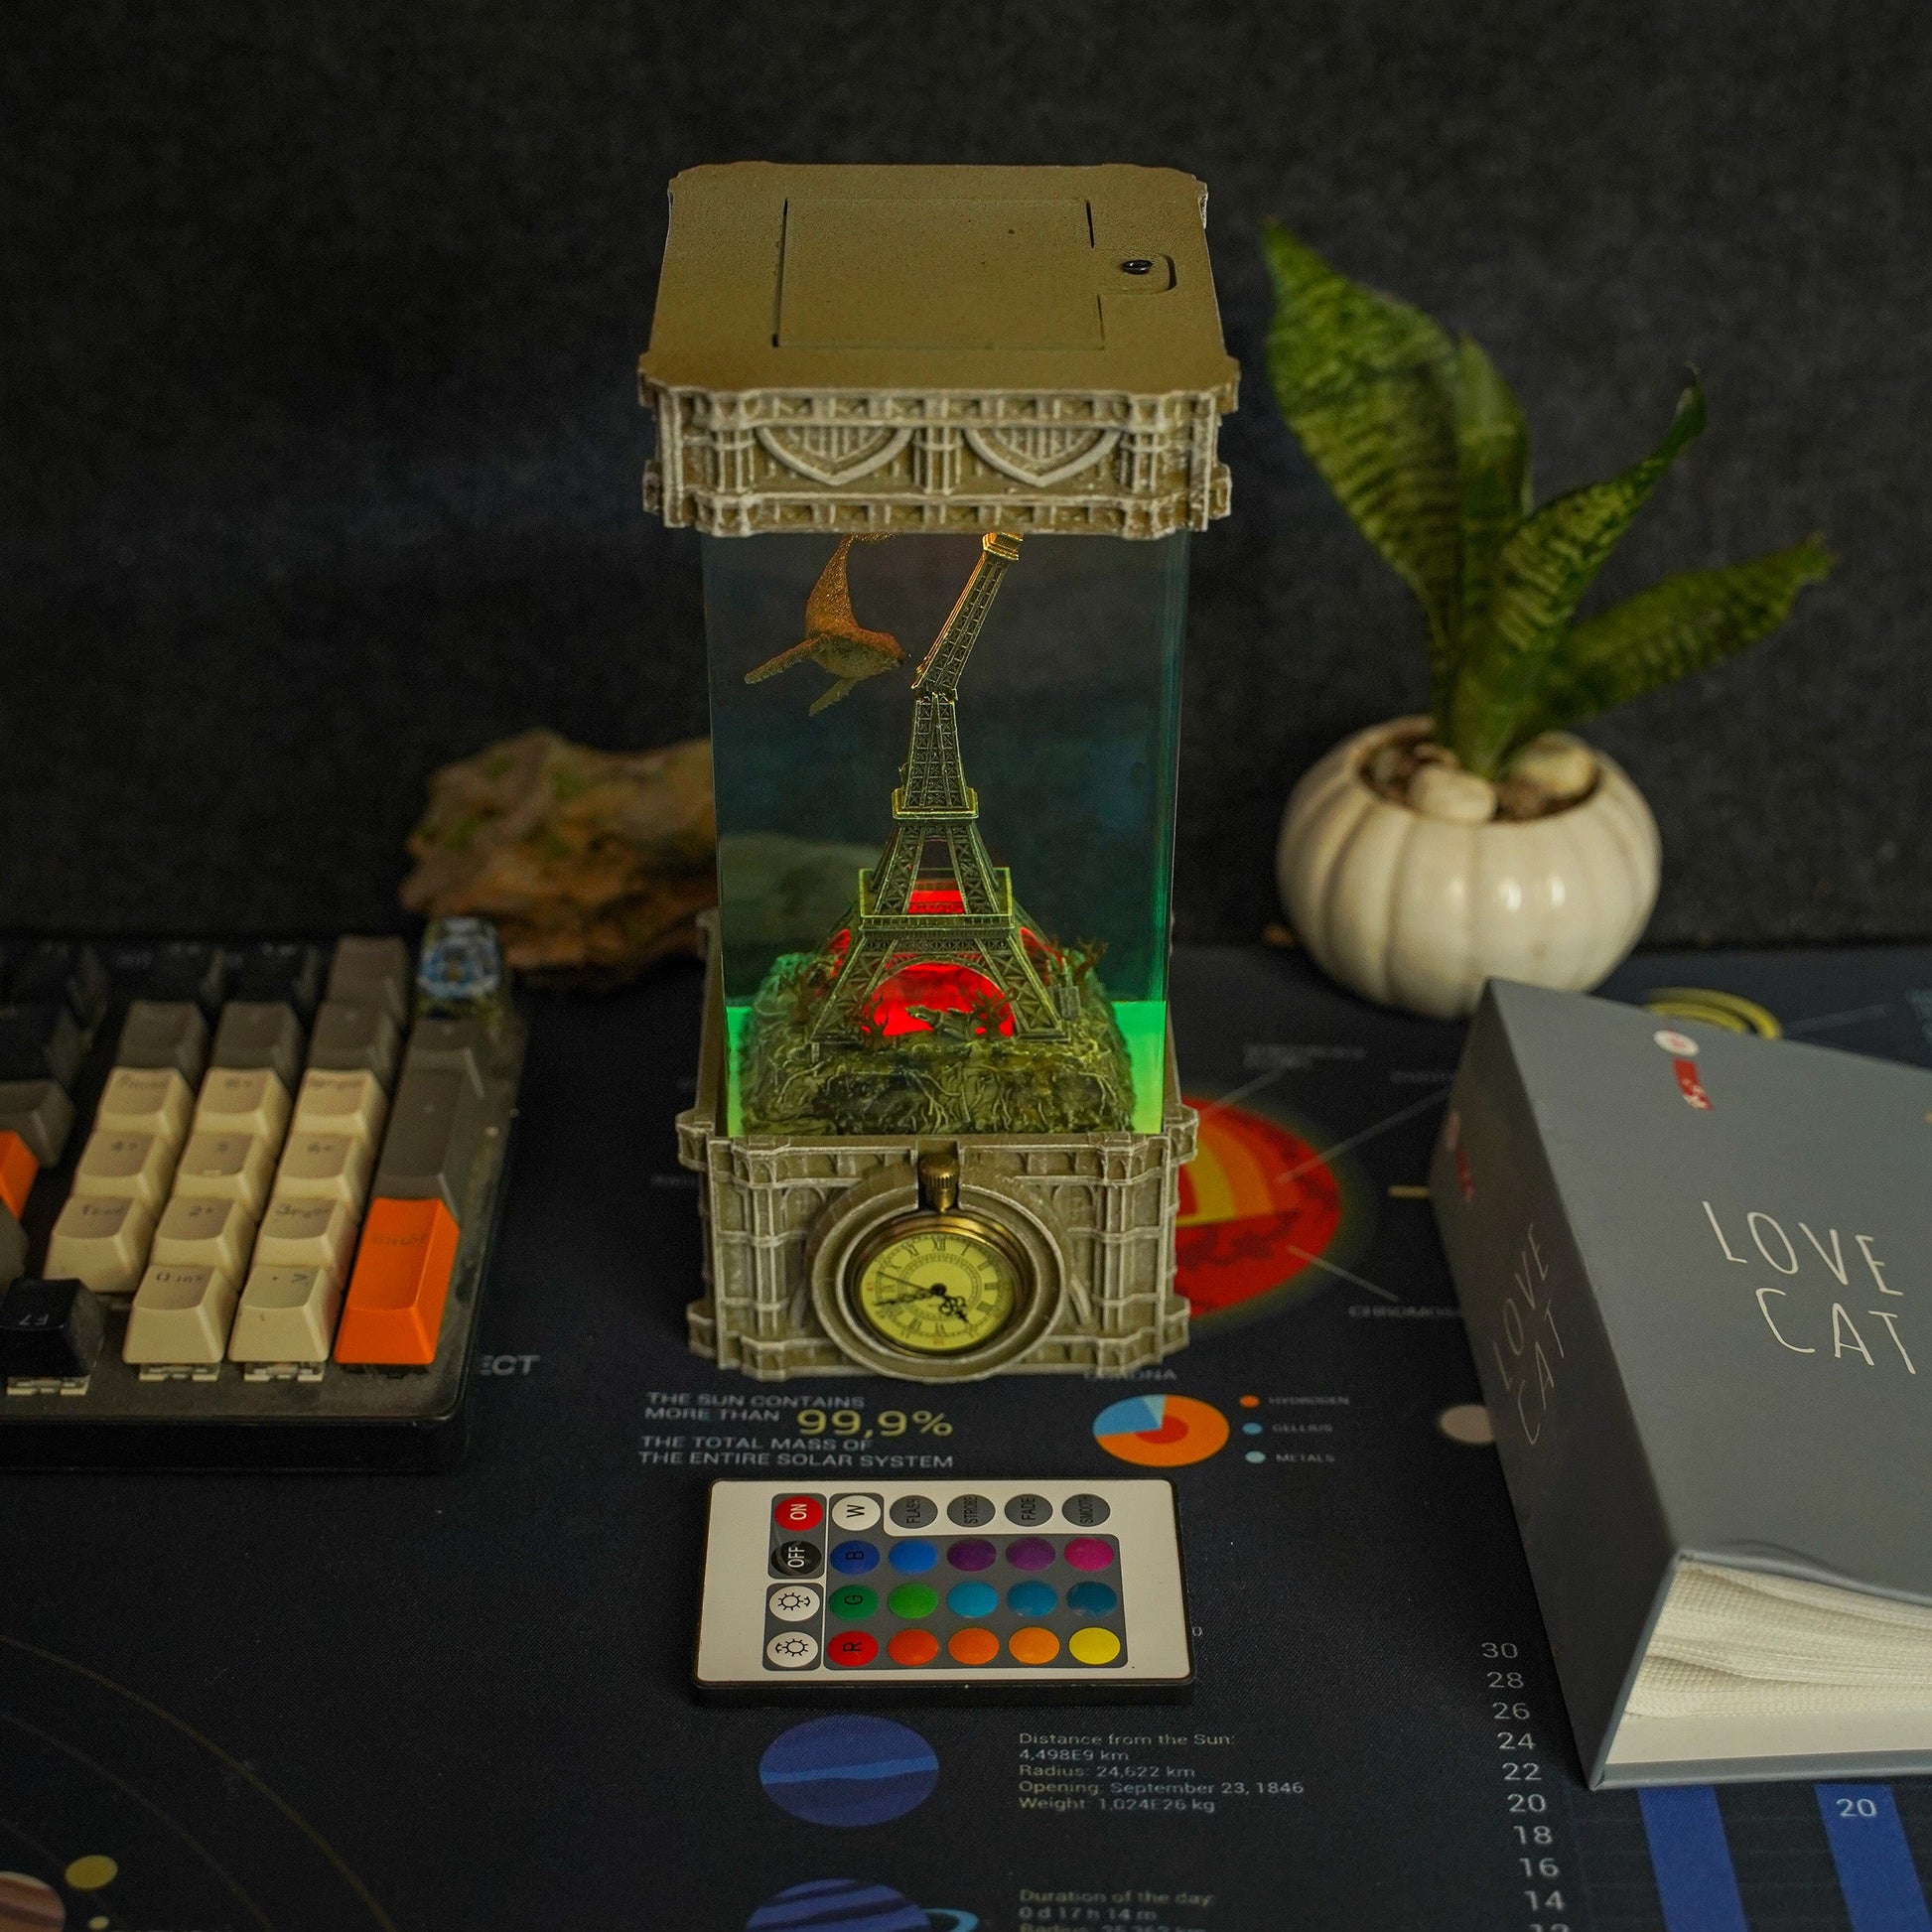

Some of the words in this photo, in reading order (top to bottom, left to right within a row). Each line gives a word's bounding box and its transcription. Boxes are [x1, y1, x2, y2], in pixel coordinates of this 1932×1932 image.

[1702, 1200, 1904, 1297] LOVE
[1492, 1222, 1549, 1391] LOVE
[1755, 1288, 1916, 1375] CAT
[1516, 1299, 1565, 1446] CAT
[646, 1392, 691, 1406] THE
[697, 1393, 745, 1408] SUN
[750, 1395, 865, 1409] CONTAINS
[645, 1407, 712, 1421] MORE
[719, 1408, 780, 1422] THAN
[796, 1409, 953, 1439] 99,9%
[641, 1436, 686, 1449] THE
[692, 1436, 763, 1450] TOTAL
[771, 1438, 837, 1451] MASS
[843, 1439, 873, 1452] OF
[638, 1450, 684, 1465] THE
[689, 1451, 770, 1466] ENTIRE
[776, 1452, 853, 1467] SOLAR
[860, 1454, 954, 1468] SYSTEM
[790, 1503, 807, 1521] ON
[847, 1504, 866, 1518] W
[963, 1496, 978, 1525] STROBE
[1022, 1496, 1036, 1521] FADE
[787, 1546, 805, 1568] OFF
[846, 1550, 864, 1560] B
[844, 1594, 863, 1605] G
[842, 1641, 863, 1652] R
[1481, 1641, 1519, 1660] 30
[1486, 1671, 1524, 1690] 28
[1492, 1702, 1531, 1721] 26
[1019, 1732, 1102, 1745] Distance
[1108, 1733, 1152, 1745] from
[1158, 1733, 1187, 1745] the
[1497, 1731, 1536, 1750] 24
[1019, 1748, 1094, 1761] 4,498E9
[1100, 1749, 1130, 1761] km
[1096, 1765, 1160, 1778] 24,622
[1167, 1765, 1195, 1778] km
[1502, 1762, 1542, 1781] 22
[1109, 1781, 1215, 1796] September
[1221, 1781, 1251, 1795] 23,
[1256, 1781, 1305, 1795] 1846
[1192, 1798, 1216, 1814] kg
[1507, 1793, 1547, 1813] 20
[1836, 1798, 1878, 1818] 20
[1513, 1825, 1554, 1846] 18
[1518, 1858, 1560, 1878] 16
[1019, 1888, 1107, 1903] Duration
[1111, 1889, 1132, 1903] of
[1137, 1890, 1170, 1904] the
[1524, 1890, 1566, 1911] 14
[1108, 1906, 1132, 1921] 14
